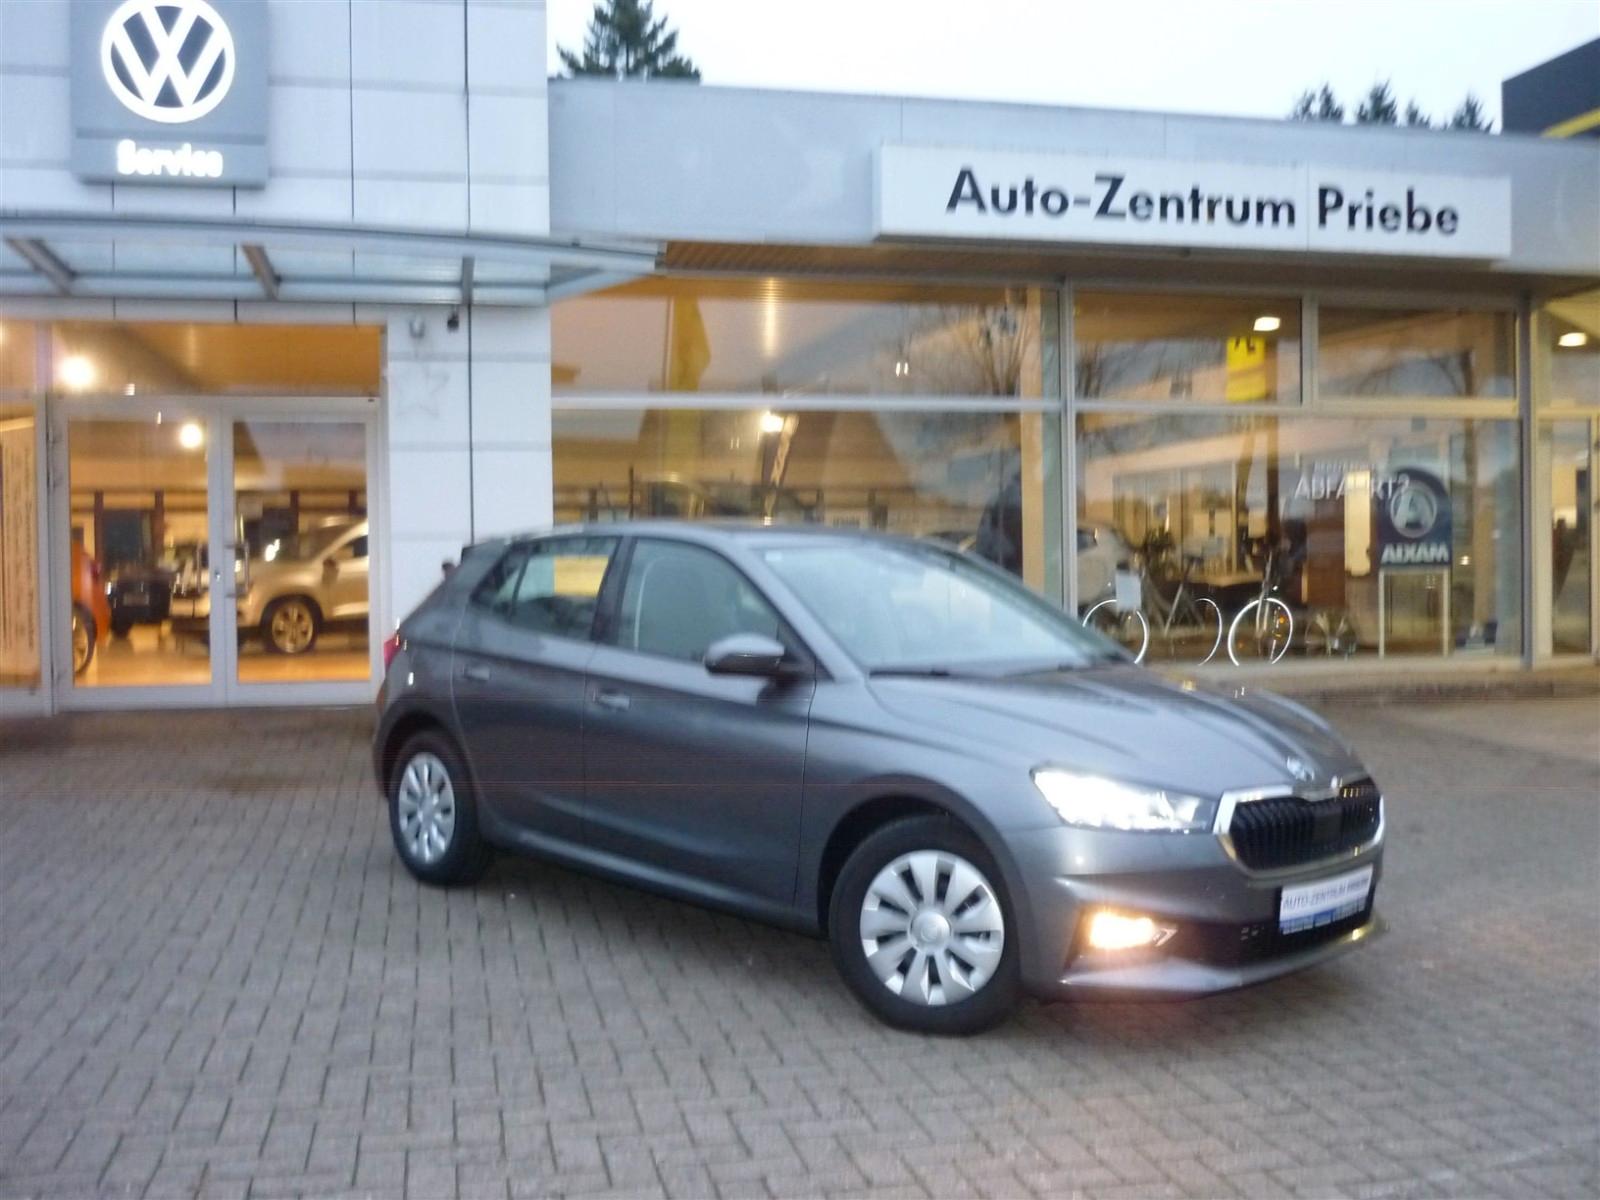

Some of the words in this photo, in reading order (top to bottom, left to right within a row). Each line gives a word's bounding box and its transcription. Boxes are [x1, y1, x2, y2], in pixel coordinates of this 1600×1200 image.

[116, 138, 223, 177] Service
[946, 165, 1296, 228] Auto-Zentrum
[1317, 183, 1459, 235] Priebe
[1381, 543, 1449, 564] AIXAM
